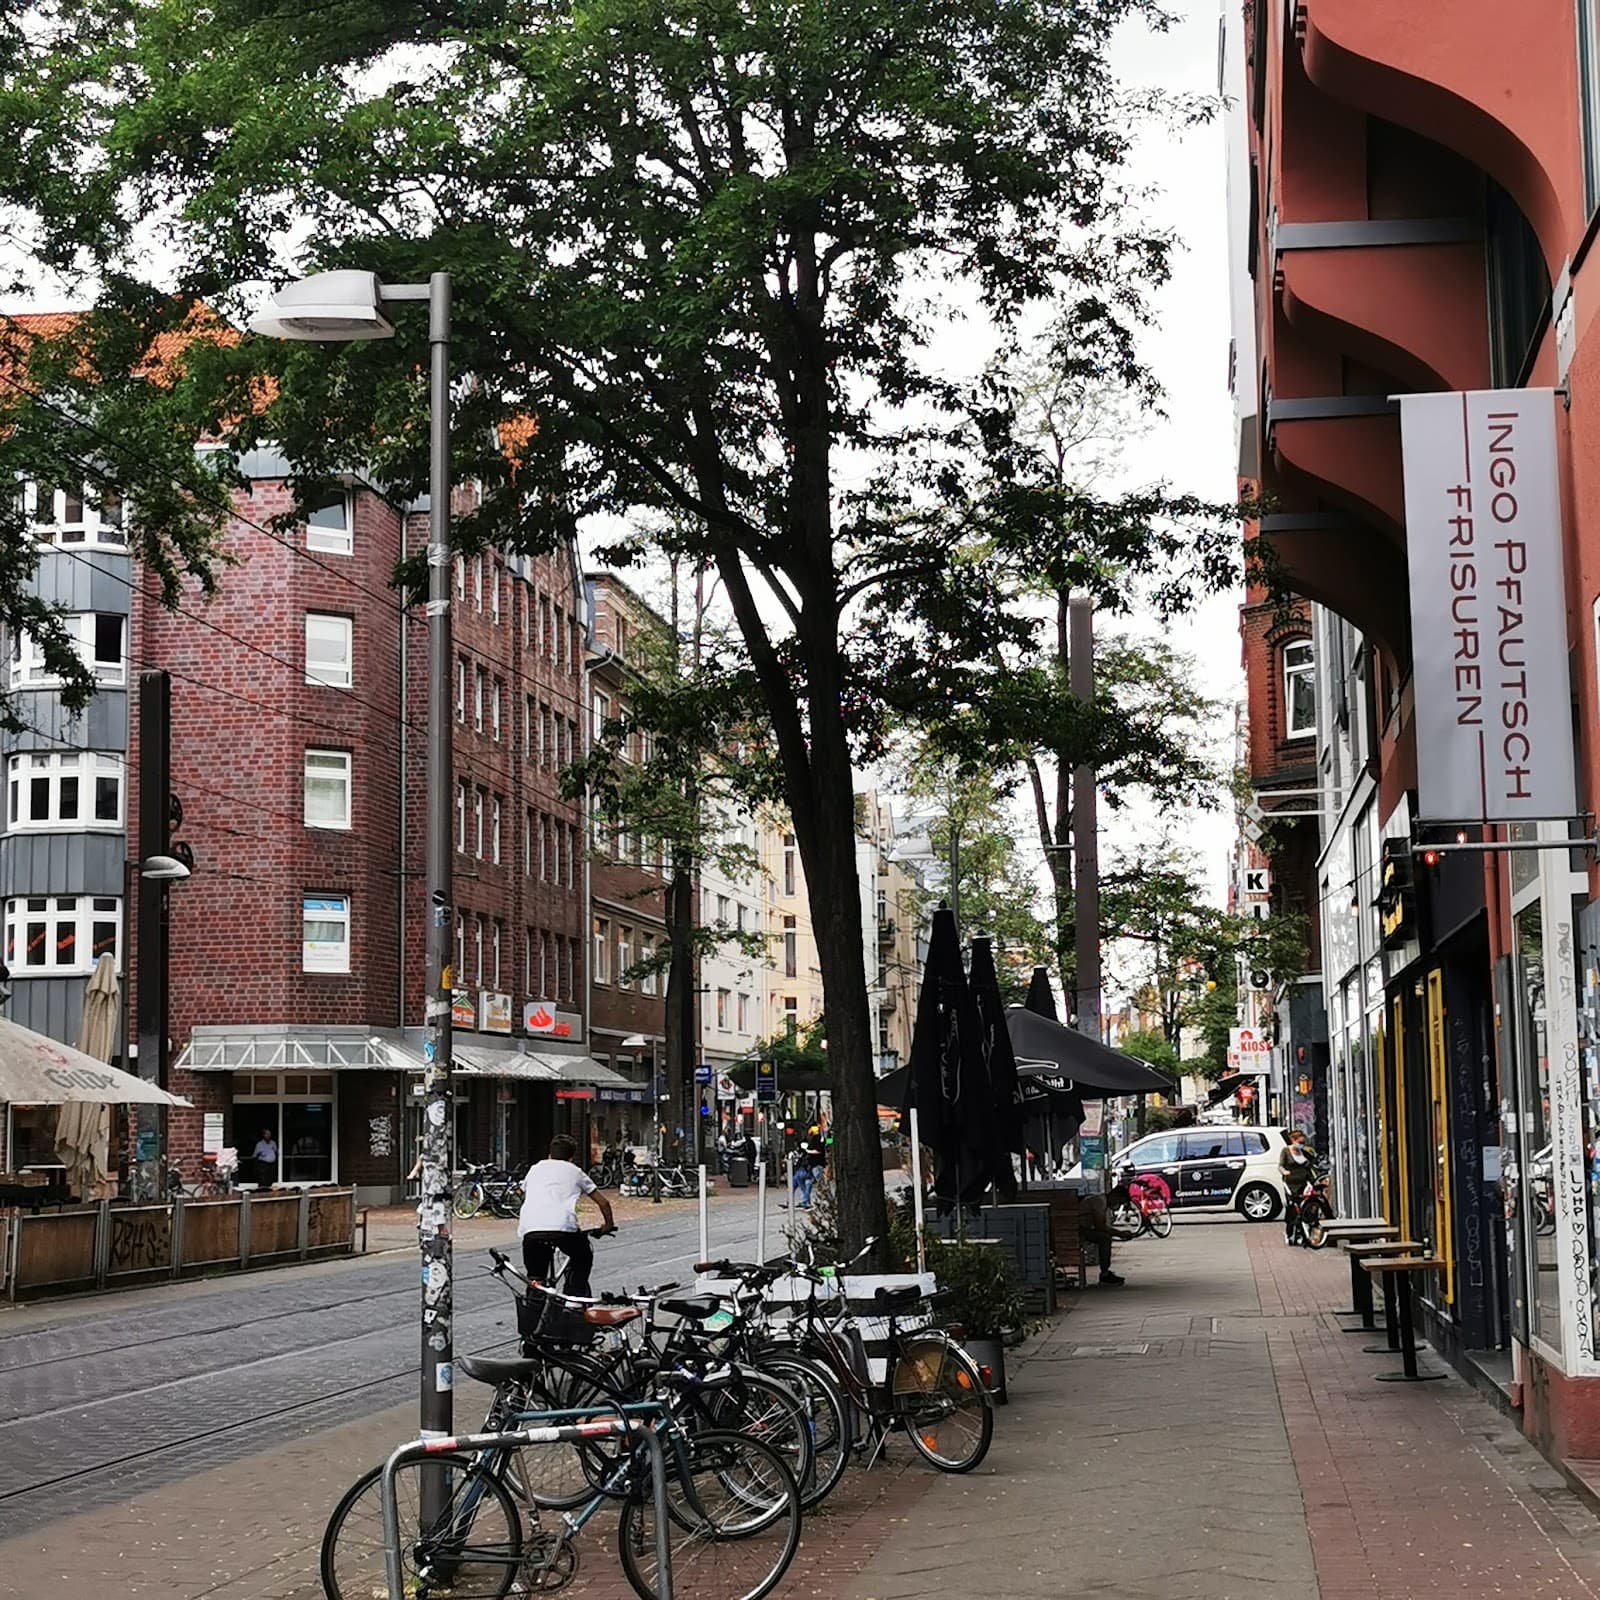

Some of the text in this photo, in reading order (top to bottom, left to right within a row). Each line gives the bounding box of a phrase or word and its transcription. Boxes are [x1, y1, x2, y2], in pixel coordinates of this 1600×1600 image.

[1447, 484, 1483, 727] FRISUREN
[1487, 412, 1532, 799] INGO PFAUTSCH
